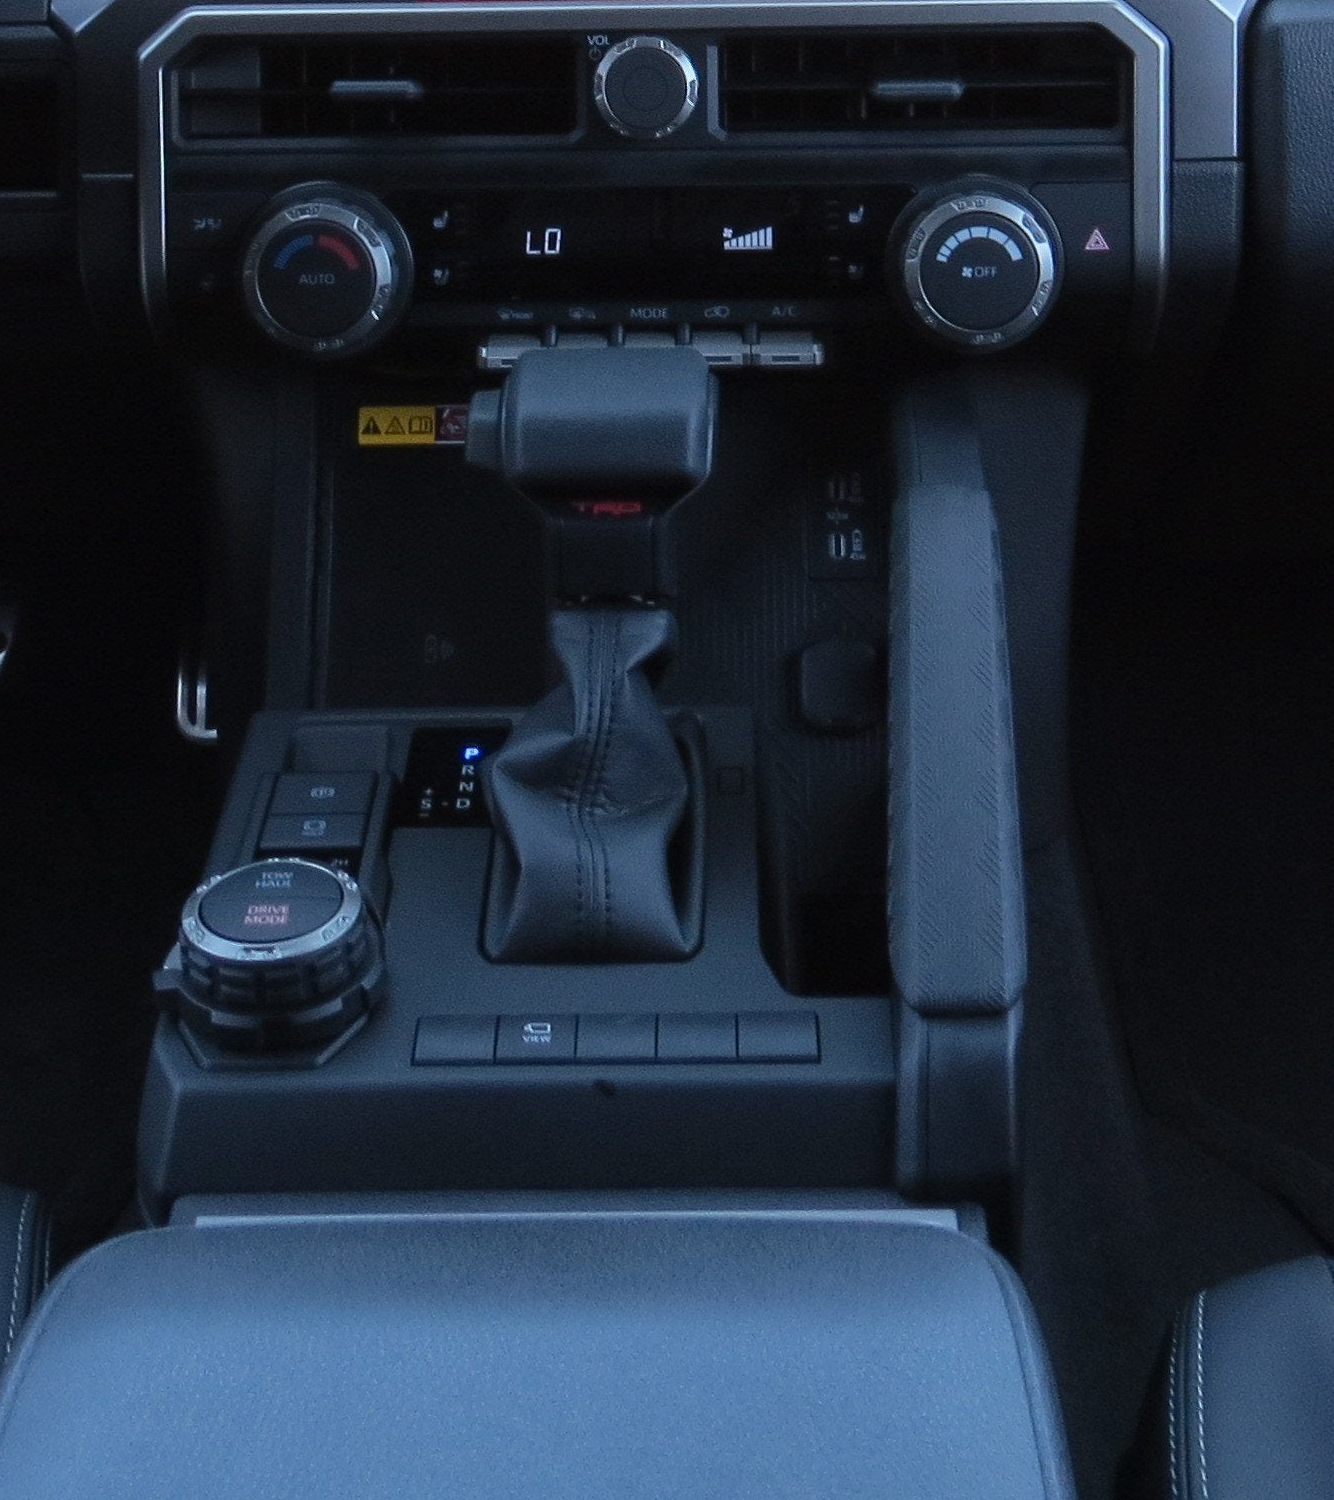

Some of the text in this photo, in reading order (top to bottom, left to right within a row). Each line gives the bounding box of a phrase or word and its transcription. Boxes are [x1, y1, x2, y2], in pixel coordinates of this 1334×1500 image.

[526, 228, 562, 255] LO
[975, 266, 998, 279] OFF
[299, 273, 335, 285] AUTO
[630, 307, 668, 319] MODE
[771, 306, 797, 317] A/C
[464, 747, 479, 760] P
[461, 764, 475, 776] R
[459, 781, 474, 792] N
[456, 798, 471, 809] D
[247, 904, 290, 915] DRIVE
[244, 914, 288, 925] MODE
